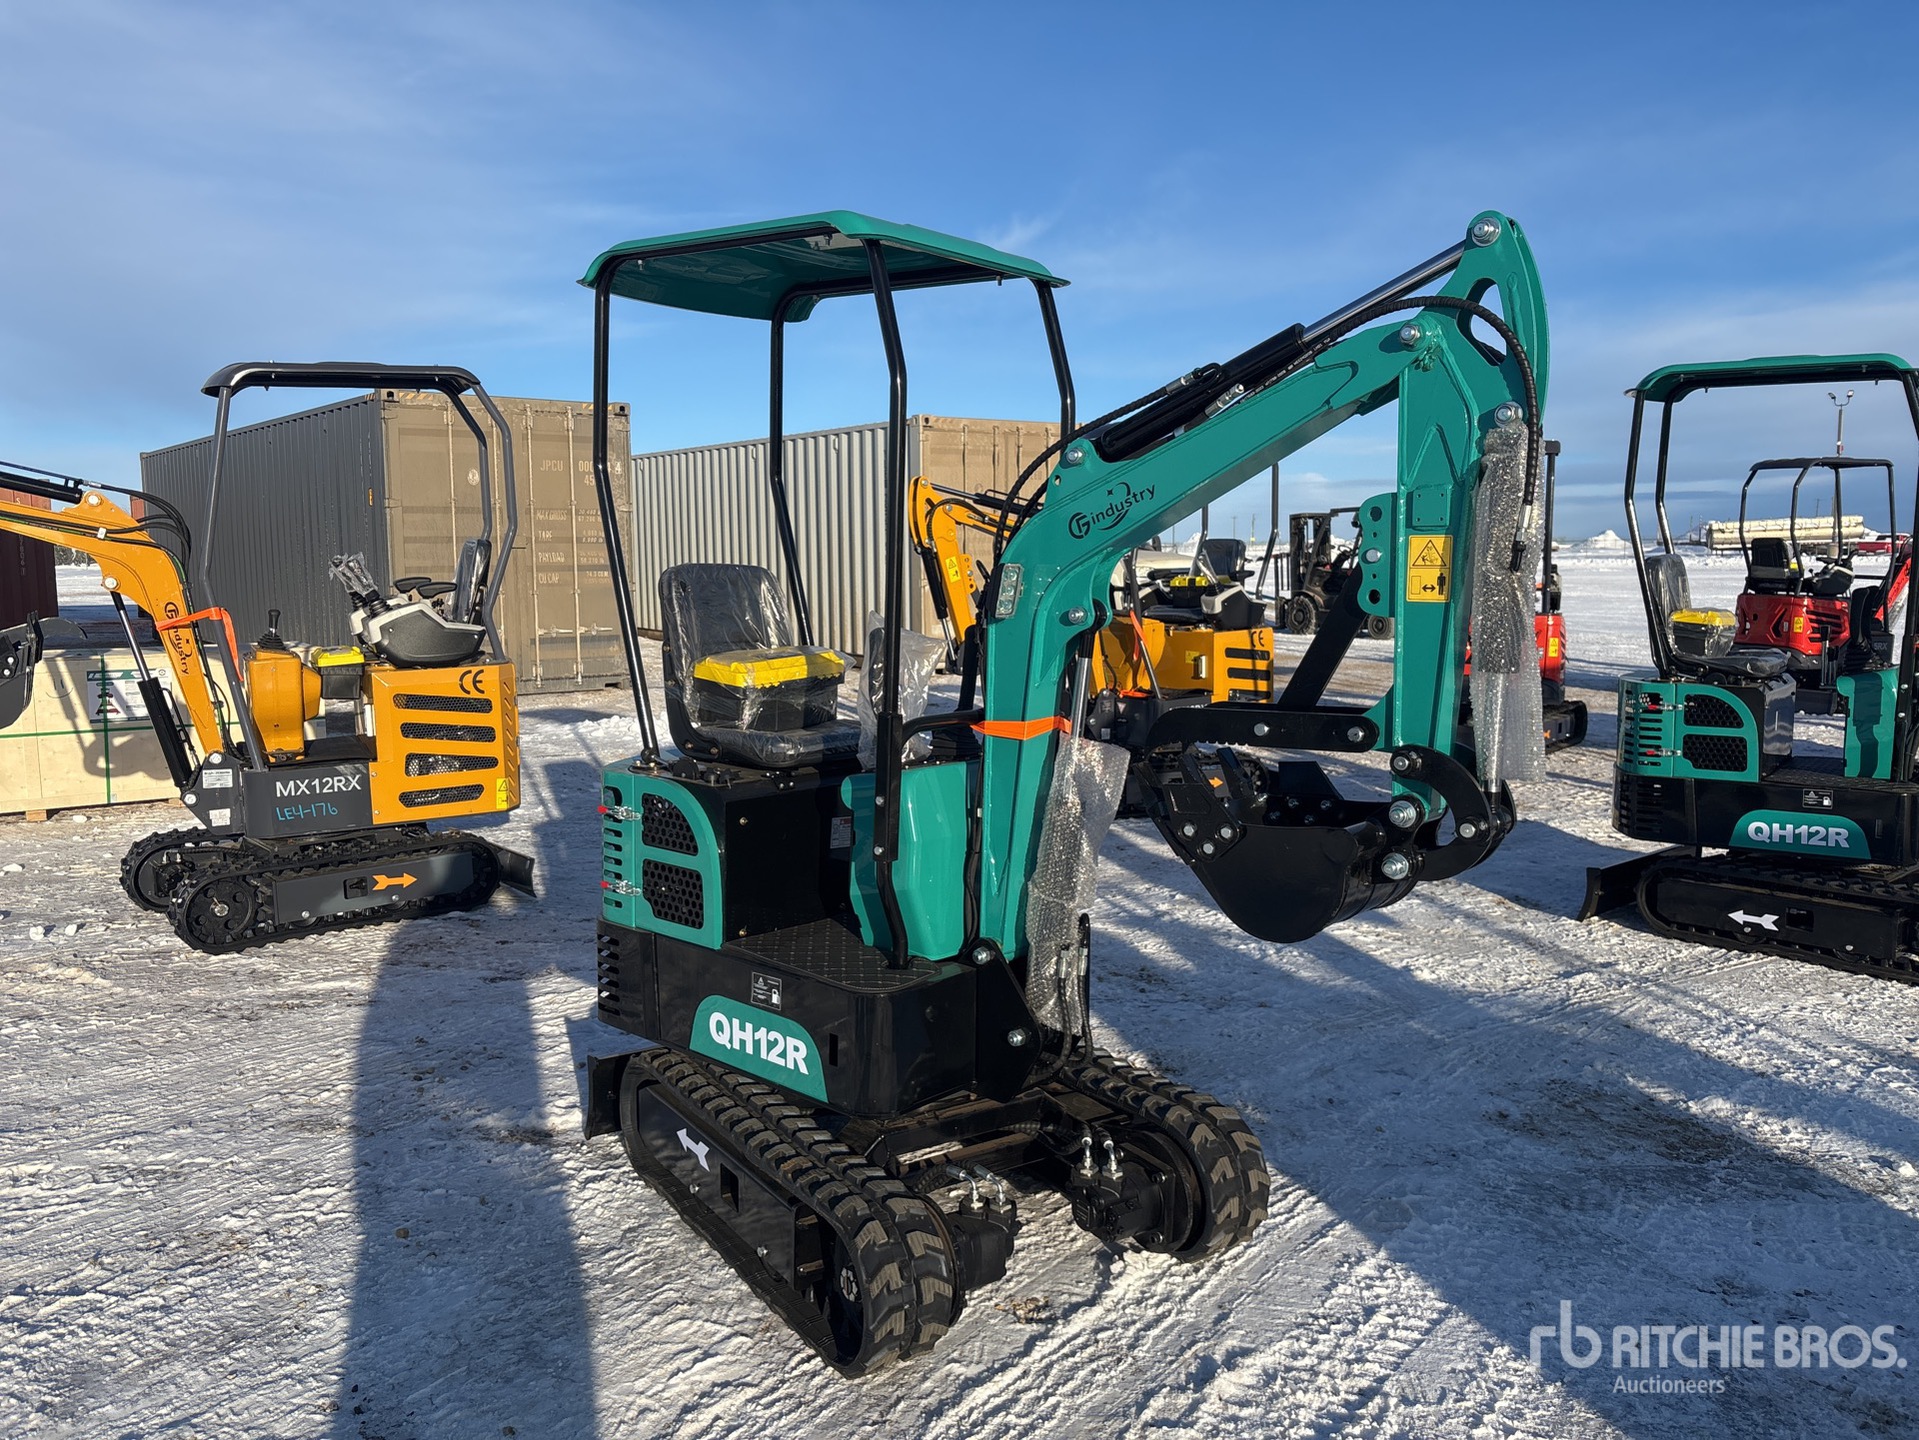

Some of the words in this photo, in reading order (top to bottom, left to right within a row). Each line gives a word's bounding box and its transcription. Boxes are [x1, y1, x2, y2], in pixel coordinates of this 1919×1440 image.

[540, 460, 564, 472] JPCU
[459, 669, 485, 695] CE
[275, 774, 362, 798] MX12RX
[276, 802, 338, 821] LE4-176
[1747, 821, 1850, 849] QH12R
[709, 1011, 809, 1076] QH12R
